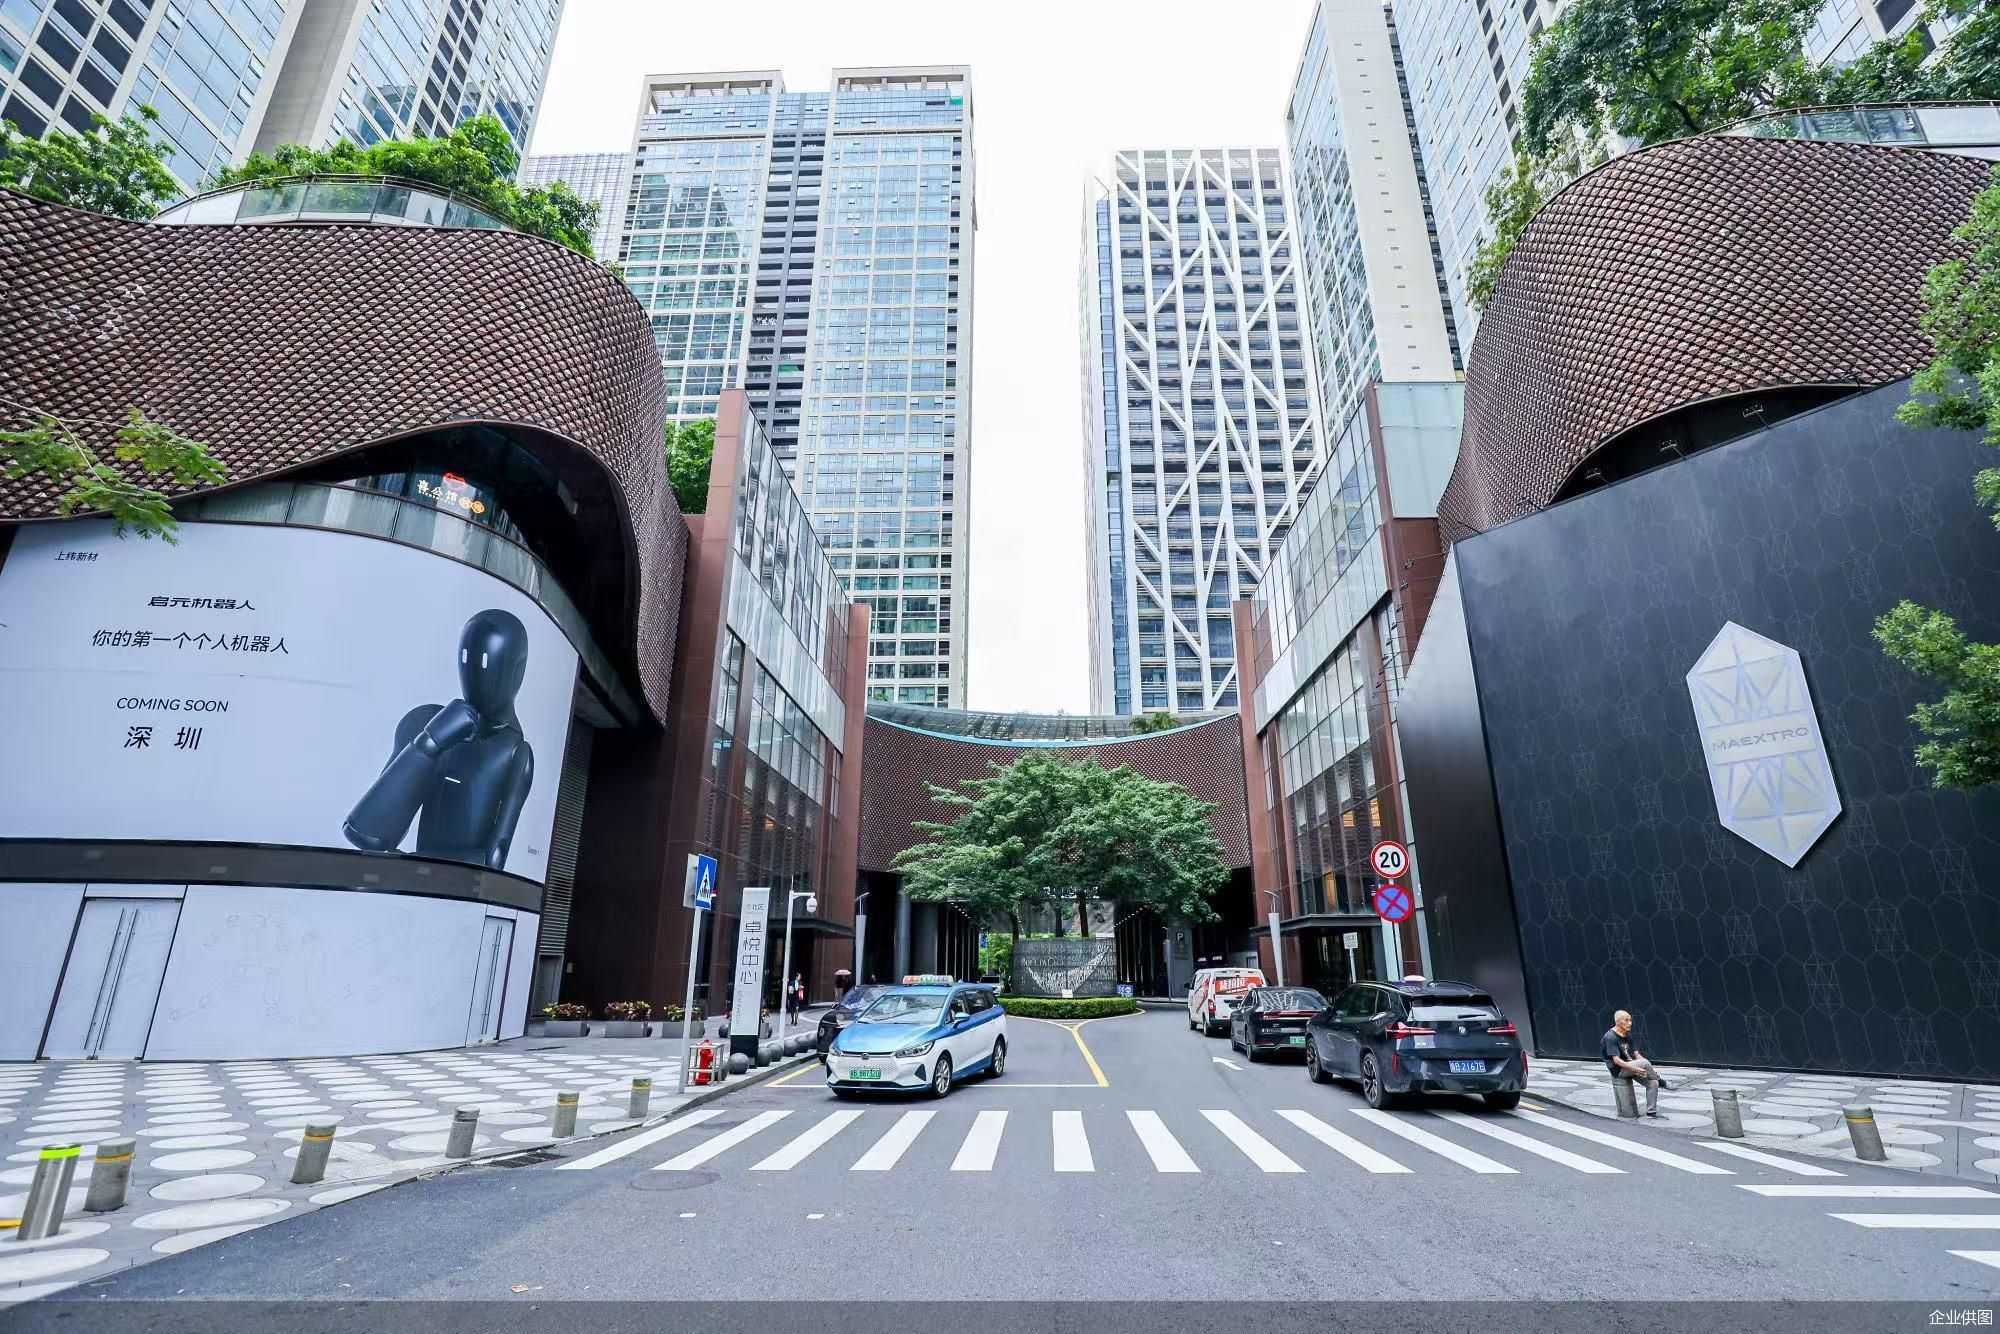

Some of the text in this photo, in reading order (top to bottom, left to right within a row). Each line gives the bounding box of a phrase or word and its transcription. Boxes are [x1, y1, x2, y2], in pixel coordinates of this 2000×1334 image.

[54, 550, 99, 562] 上纬新材
[147, 595, 256, 611] 启元机器人
[91, 629, 289, 655] 你的第一个个人机器人
[116, 697, 229, 713] COMING SOON
[1712, 727, 1810, 752] MAEXTRO
[1379, 851, 1401, 869] 20
[740, 920, 762, 985] 卓悦中心
